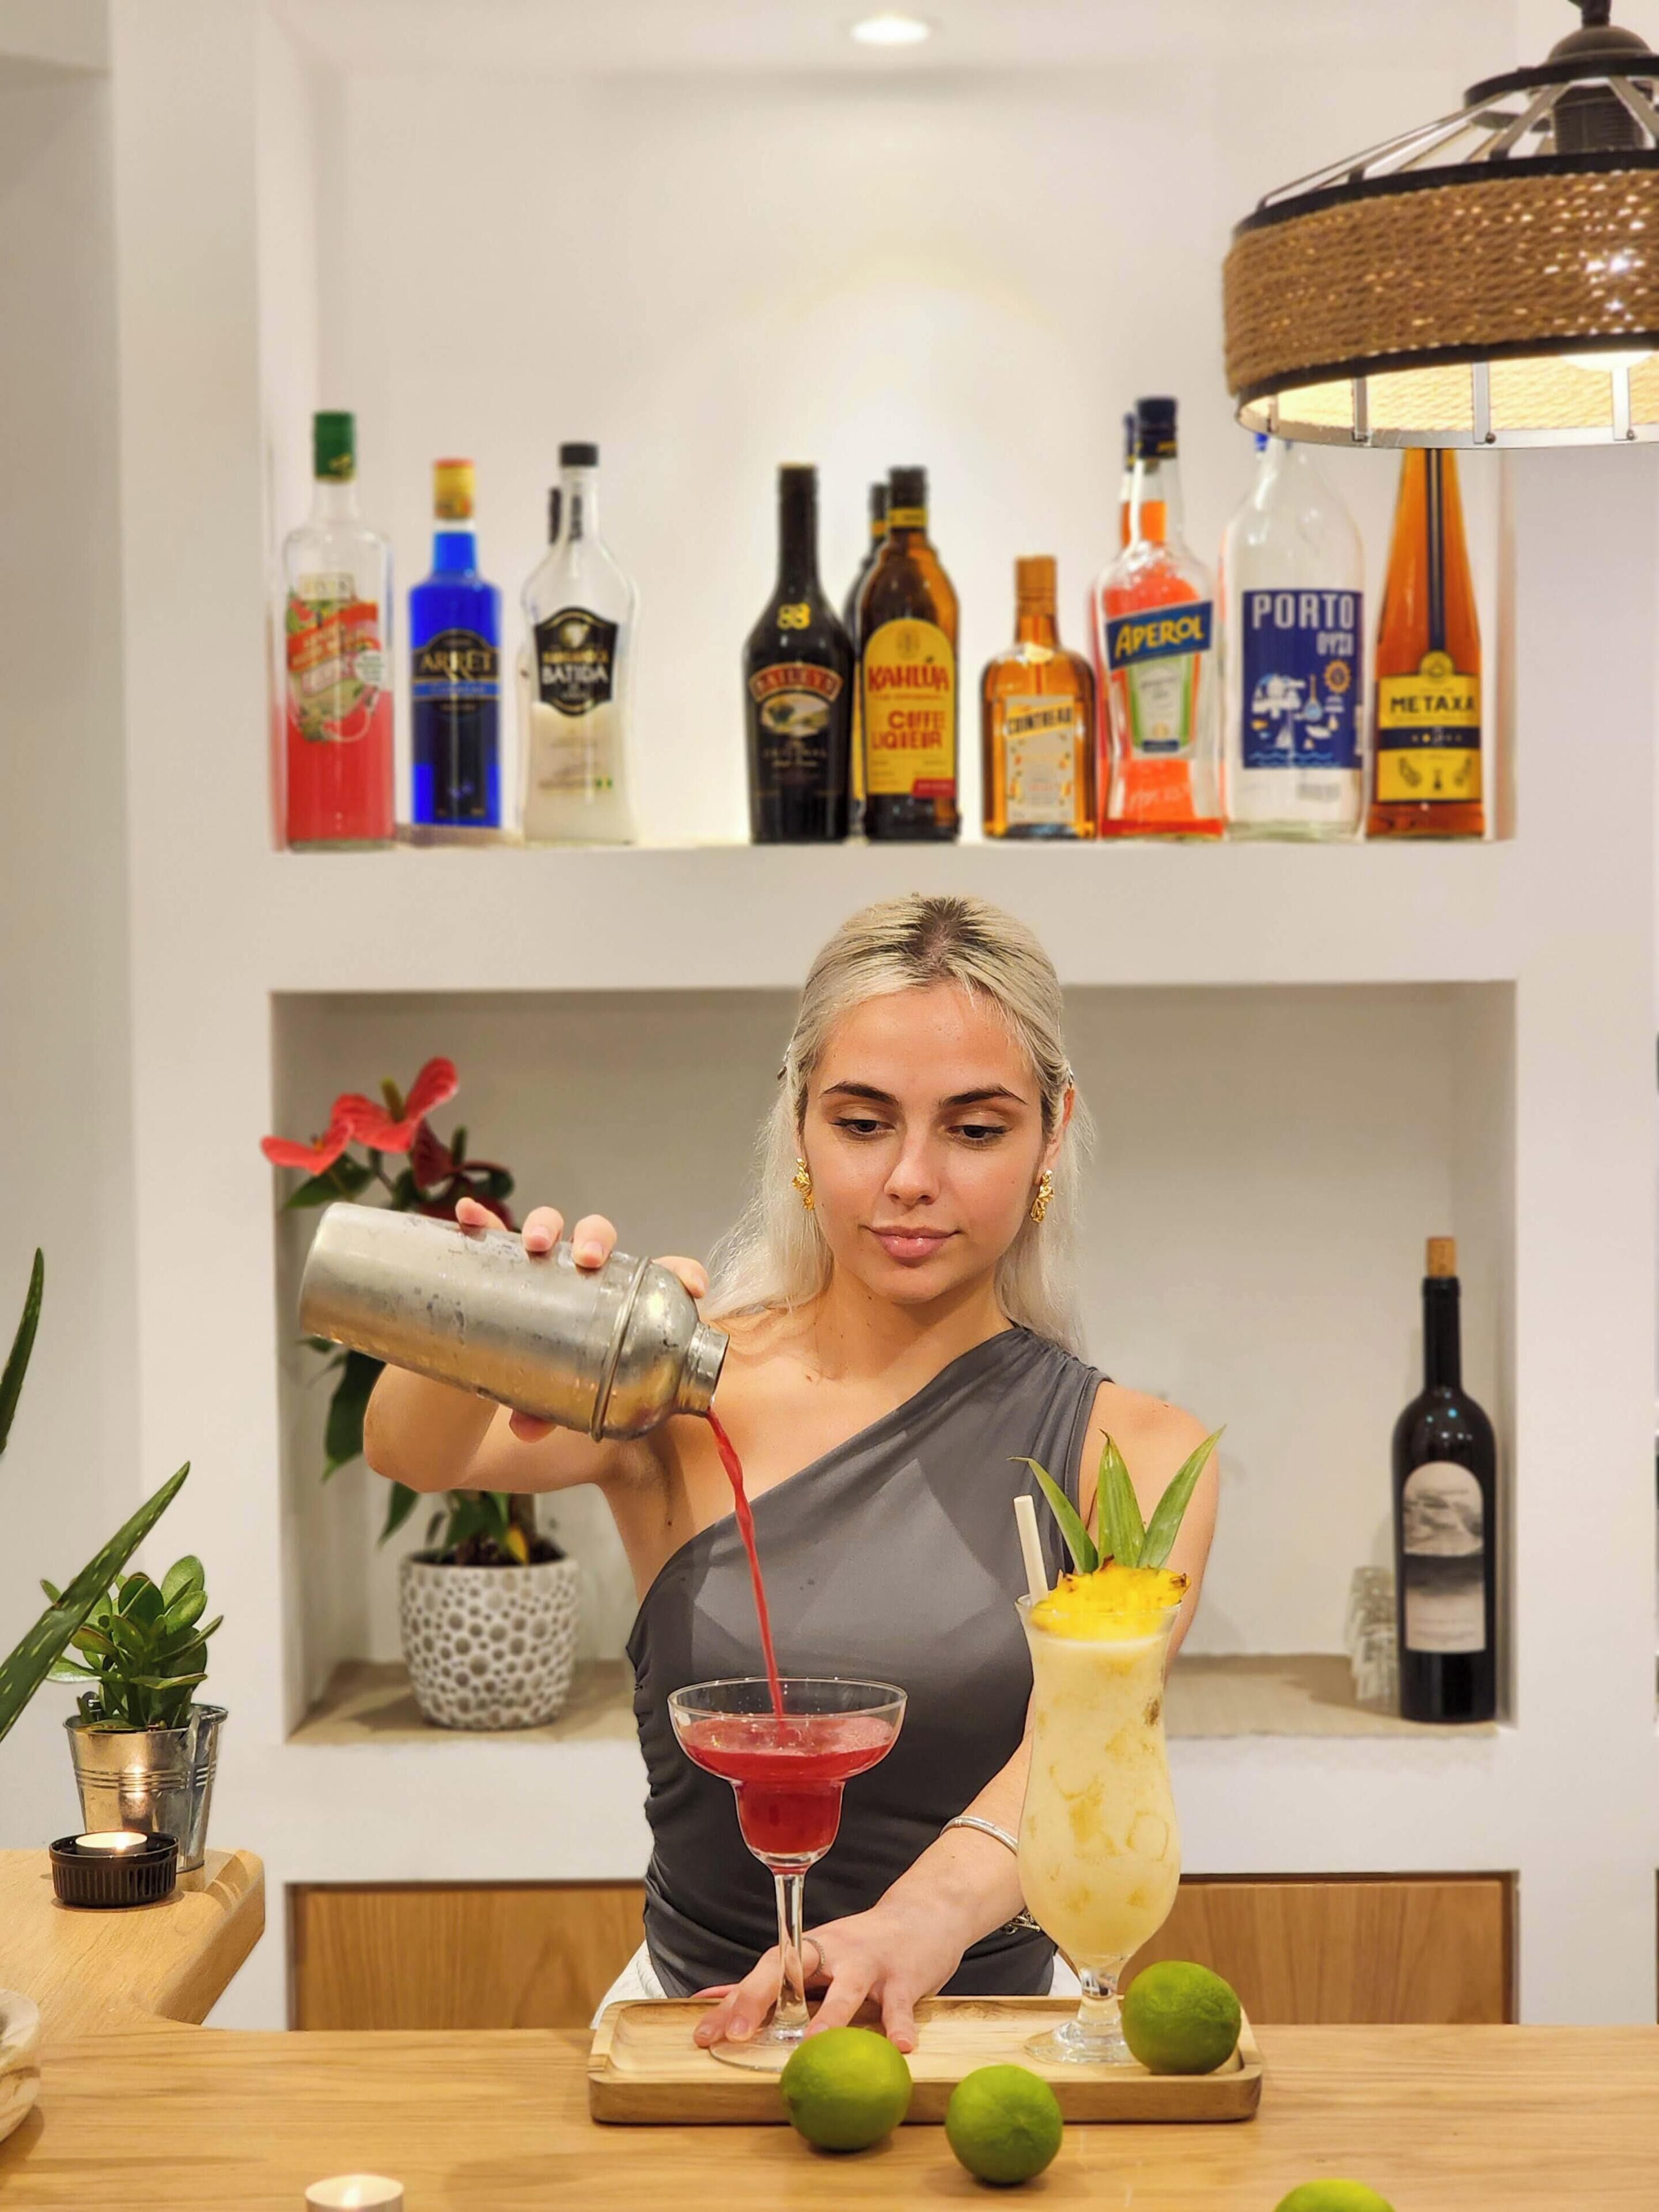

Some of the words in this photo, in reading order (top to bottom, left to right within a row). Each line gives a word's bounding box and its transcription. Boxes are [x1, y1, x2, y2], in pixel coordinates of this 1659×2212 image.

[1252, 593, 1354, 630] PORTO
[1115, 615, 1204, 660] APEROL
[542, 662, 609, 685] BATIDA
[1391, 695, 1476, 714] METAXA
